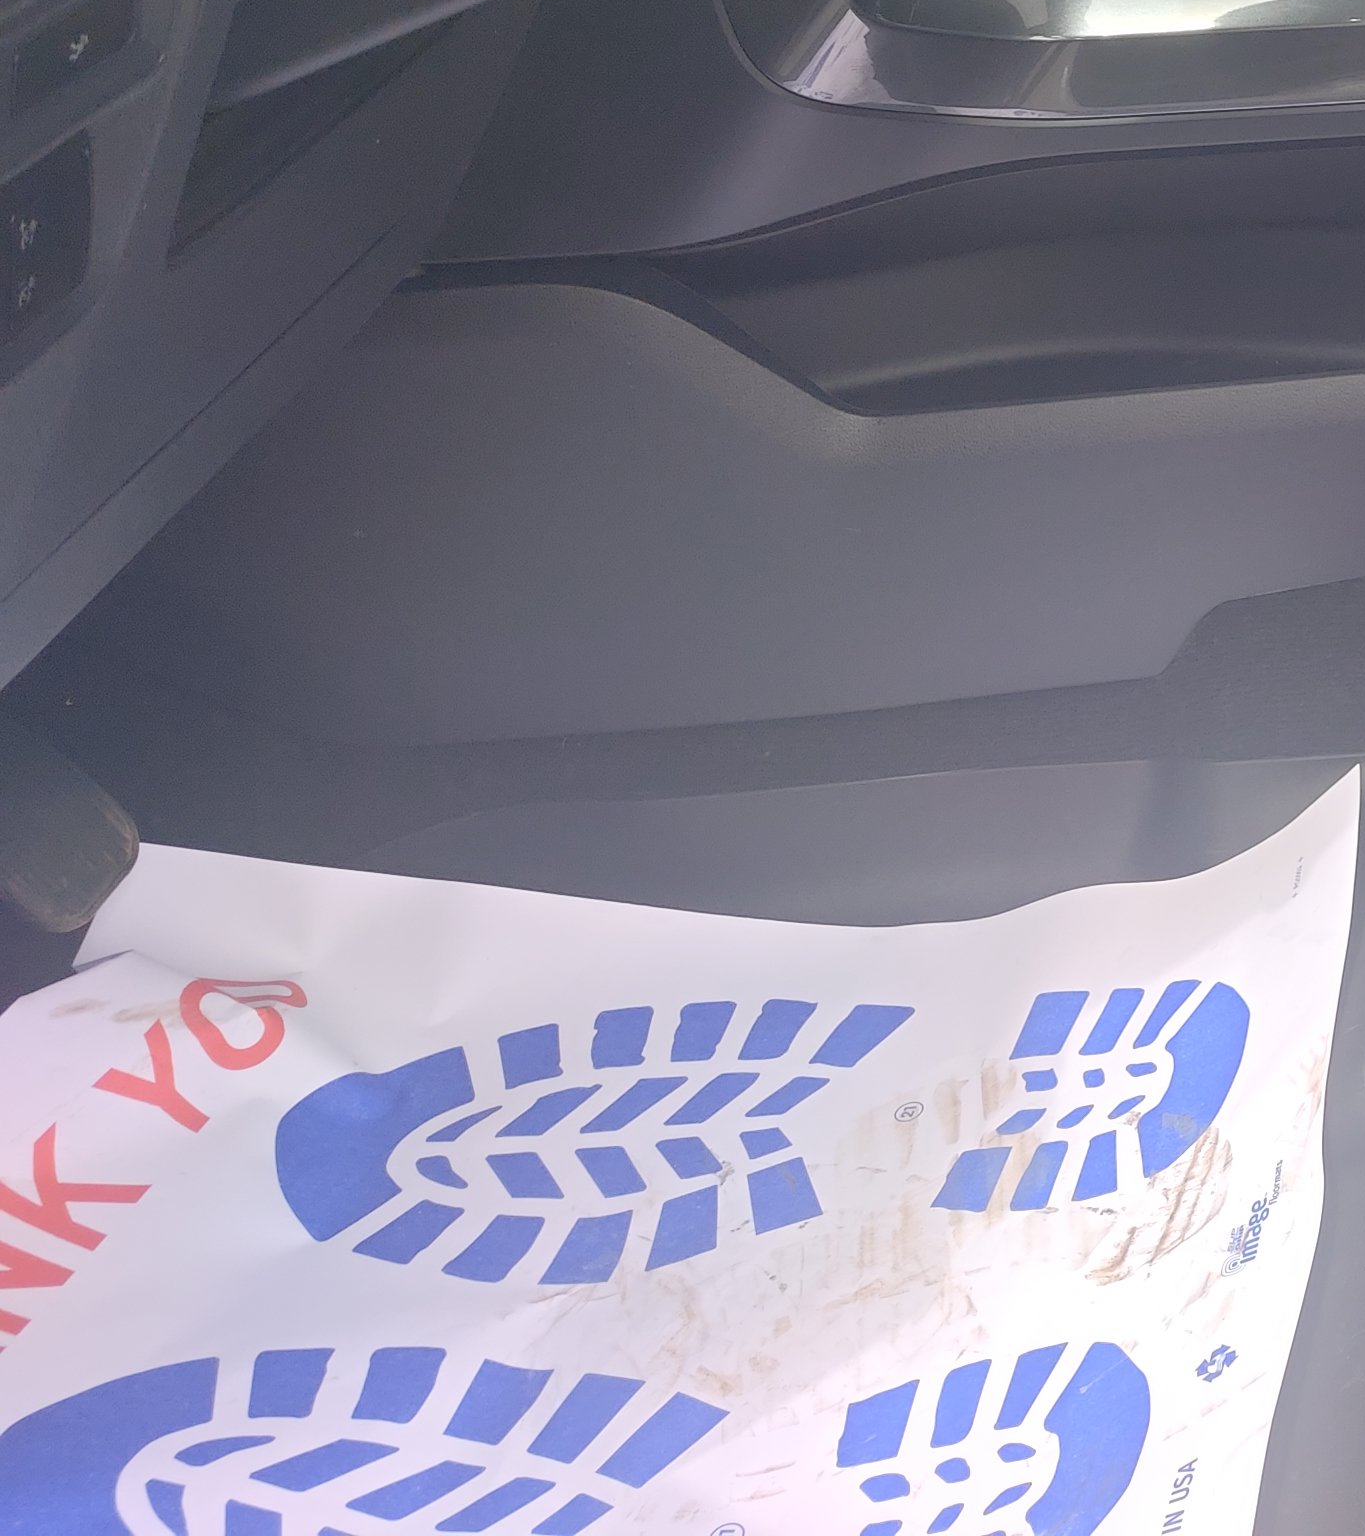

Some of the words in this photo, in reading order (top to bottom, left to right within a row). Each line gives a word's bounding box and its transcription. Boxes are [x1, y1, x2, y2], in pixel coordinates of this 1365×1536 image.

[1268, 1159, 1284, 1205] floormats
[1240, 1197, 1270, 1264] image
[1168, 1457, 1199, 1504] USA
[1161, 1509, 1185, 1535] IN
